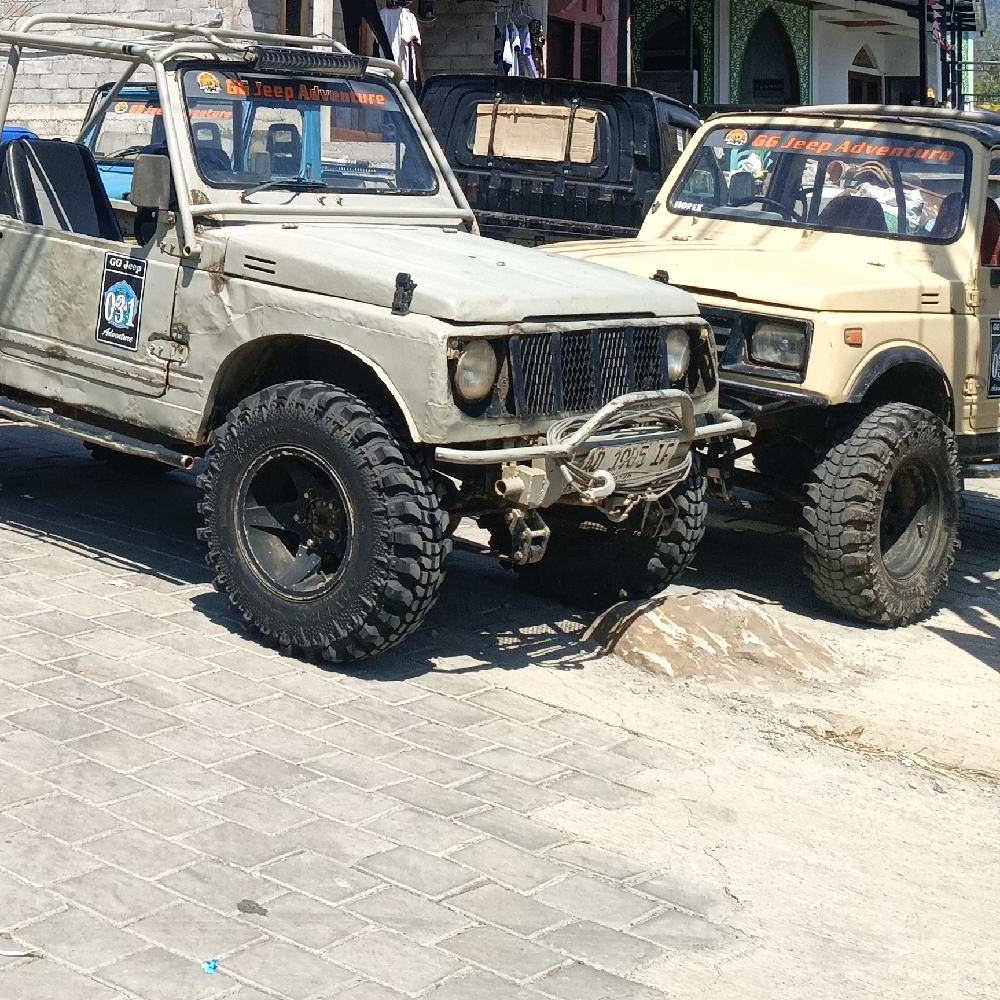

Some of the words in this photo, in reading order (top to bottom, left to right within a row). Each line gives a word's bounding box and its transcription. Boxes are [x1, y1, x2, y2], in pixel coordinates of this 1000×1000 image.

[225, 79, 249, 96] GG
[251, 81, 294, 102] Jeep
[300, 85, 386, 106] Adventure
[751, 134, 782, 148] GG
[781, 137, 833, 154] Jeep
[834, 140, 955, 162] Adventure
[122, 260, 142, 274] Jeep
[104, 291, 135, 328] 031
[101, 326, 134, 344] Adventure
[581, 448, 606, 473] AD
